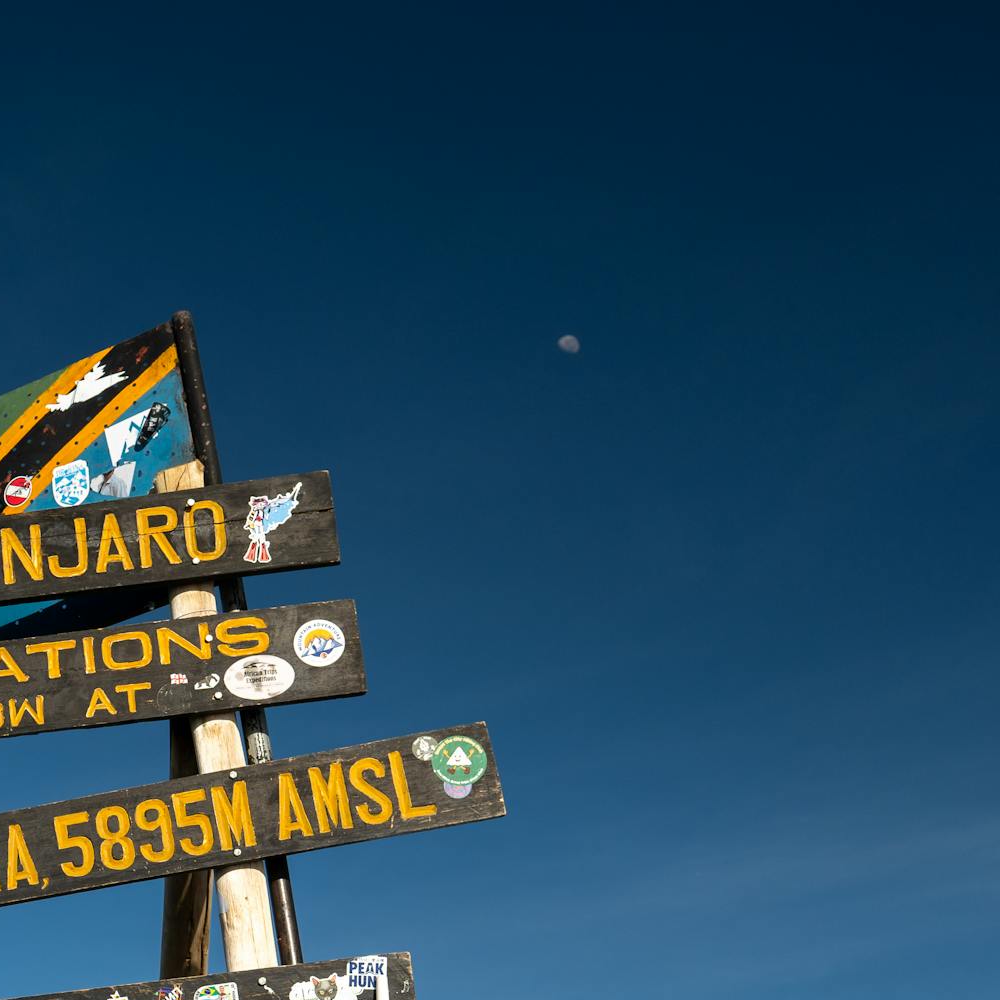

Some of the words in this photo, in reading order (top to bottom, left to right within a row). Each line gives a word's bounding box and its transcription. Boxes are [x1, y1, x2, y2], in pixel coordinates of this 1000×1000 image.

[86, 682, 152, 718] AT
[54, 780, 257, 878] 5895M
[278, 751, 437, 841] AMSL
[349, 962, 384, 975] PEAK
[349, 975, 377, 988] HUN
